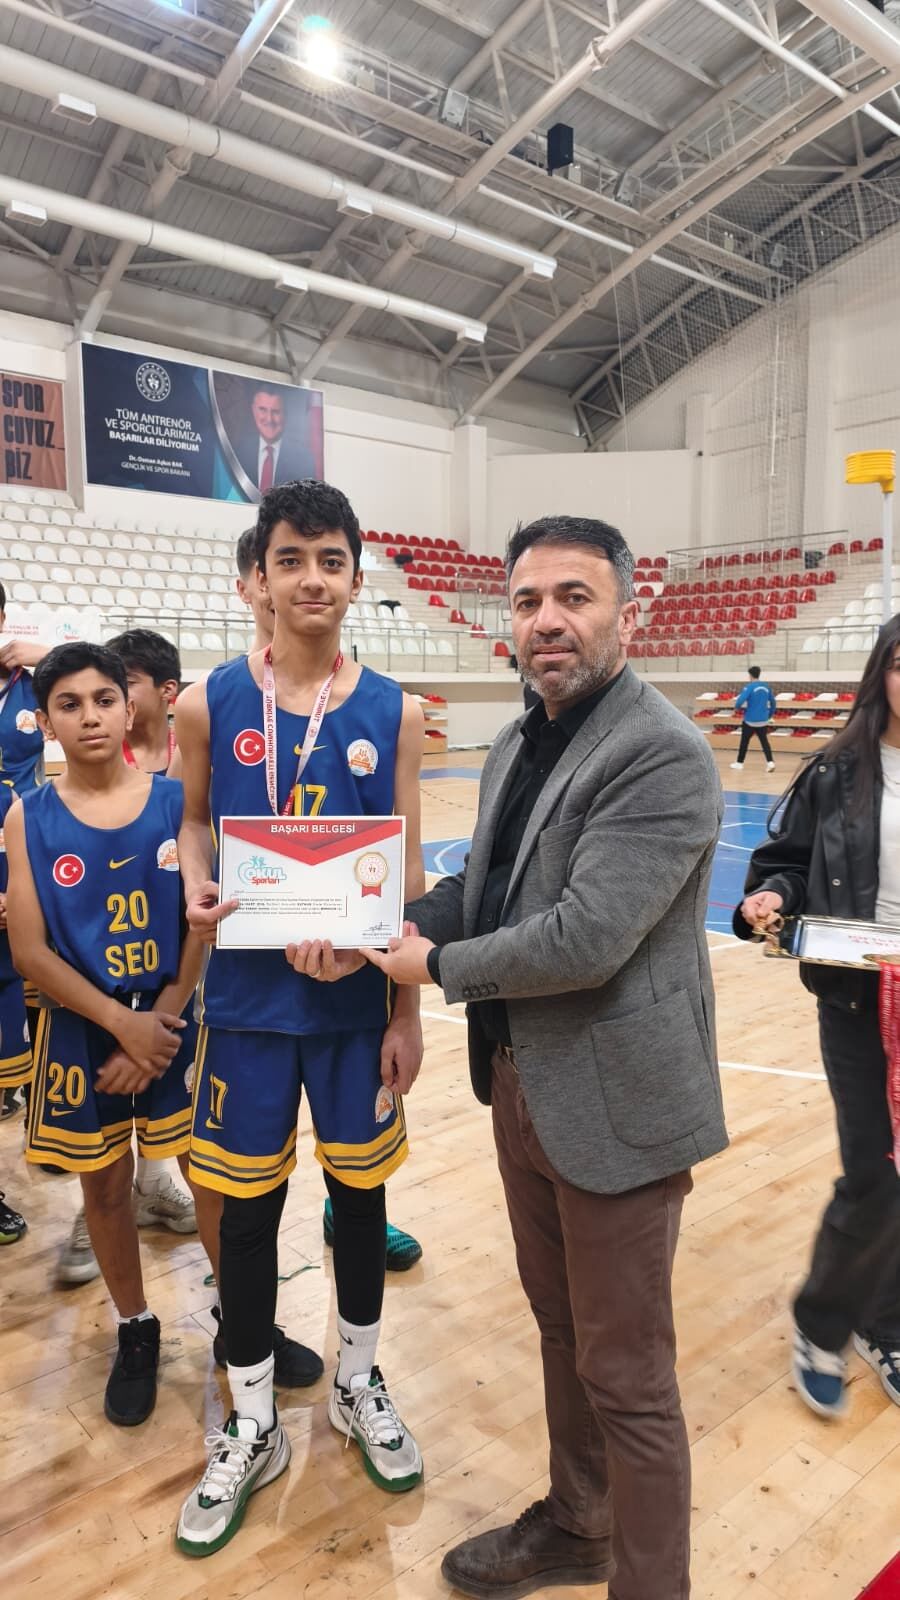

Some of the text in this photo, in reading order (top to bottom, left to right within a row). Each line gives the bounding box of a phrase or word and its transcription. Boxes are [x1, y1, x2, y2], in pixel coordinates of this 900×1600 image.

[2, 379, 44, 413] SPOR
[3, 414, 55, 449] CUYUZ
[105, 418, 202, 443] VE SPORCULARIMIZA
[116, 408, 191, 430] TÜM ANTRENÖR
[109, 431, 200, 452] BAŞARILAR DİLİYORUM
[5, 447, 32, 480] BİZ
[294, 784, 328, 816] 17
[270, 823, 356, 835] BAŞARI BELGESİ
[107, 890, 150, 934] 20
[105, 939, 160, 978] SEO
[47, 1062, 87, 1107] 20
[210, 1072, 229, 1121] 17
